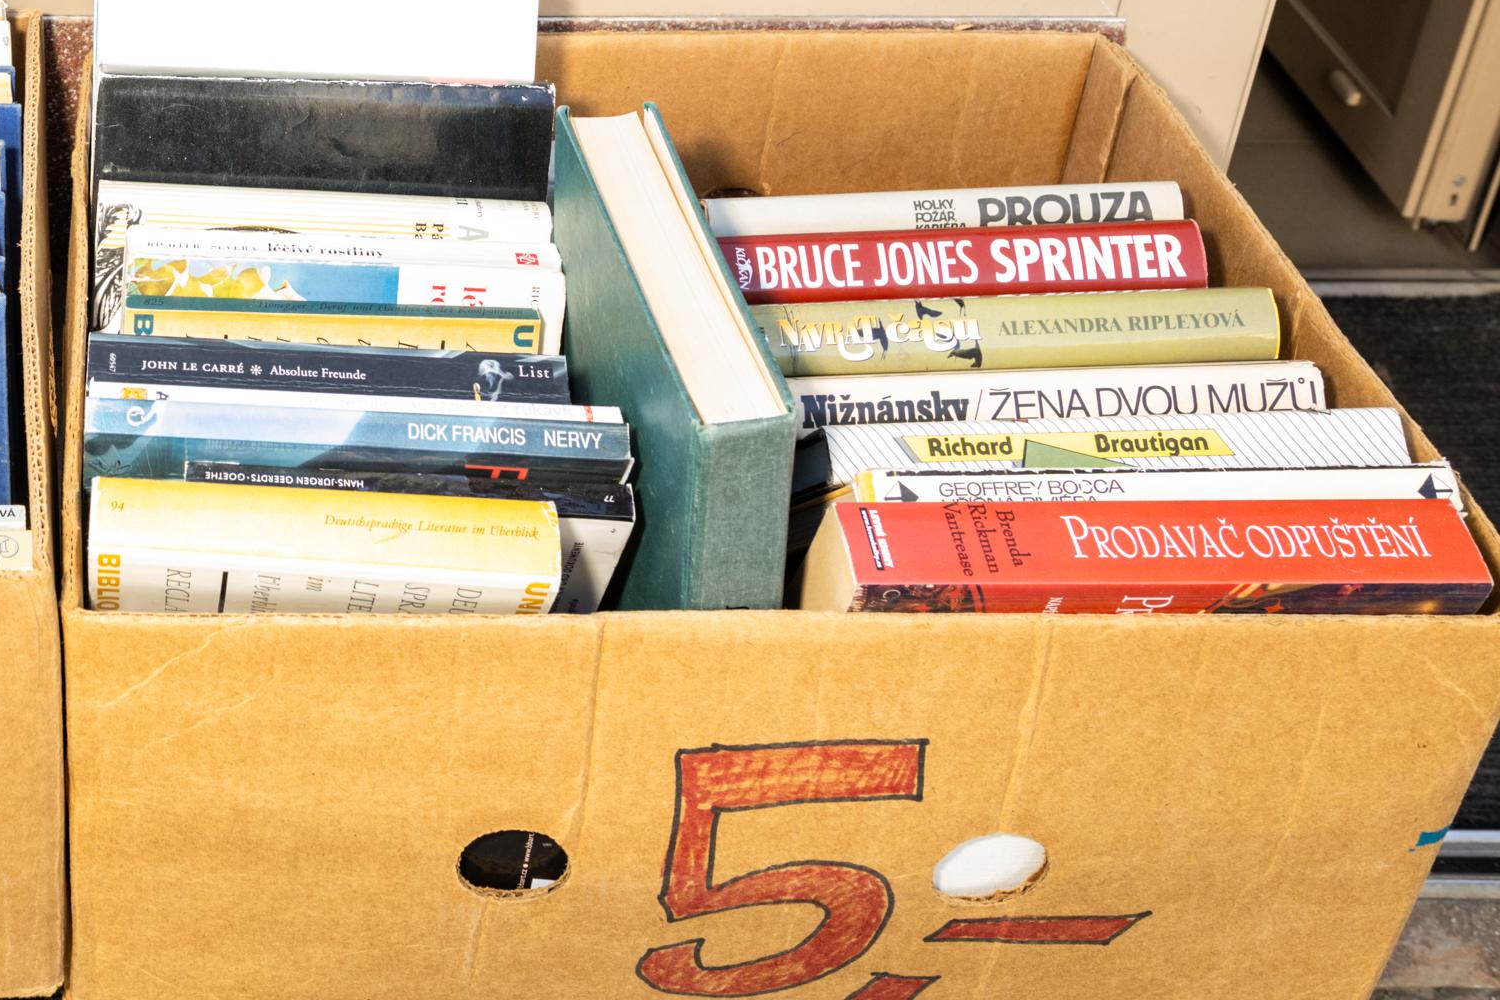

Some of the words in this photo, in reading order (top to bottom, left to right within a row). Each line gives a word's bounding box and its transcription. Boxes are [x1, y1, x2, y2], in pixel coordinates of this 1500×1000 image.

[977, 191, 1154, 228] PROUZA
[755, 242, 863, 290] BRUCE
[873, 238, 979, 285] JONES
[989, 233, 1188, 282] SPRINTER
[885, 312, 982, 351] času
[998, 316, 1123, 336] ALEXANDRA
[1127, 307, 1247, 333] RIPLEYOVÁ
[141, 358, 181, 371] JOHN
[182, 361, 199, 372] LE
[201, 359, 245, 375] CARRÉ
[268, 365, 318, 379] Absolute
[321, 368, 367, 382] Freunde
[517, 364, 551, 380] List
[801, 384, 971, 429] Nižnánsky
[987, 385, 1093, 421] ŽENA
[1097, 386, 1197, 418] DVOU
[1201, 376, 1322, 413] MUŽŮ
[407, 422, 450, 443] DICK
[452, 424, 527, 446] FRANCIS
[543, 429, 603, 450] NERVY
[926, 433, 1014, 458] Richard
[1094, 431, 1211, 458] Brautigan
[937, 478, 1044, 499] GEOFFREY
[1047, 477, 1125, 496] BOCCA
[323, 513, 414, 537] Deutschsprachige
[416, 520, 471, 536] Literatur
[471, 524, 486, 535] im
[489, 523, 540, 539] Überblick
[941, 501, 976, 578] Vantrease
[967, 501, 1000, 575] Rickman
[995, 509, 1026, 568] Brenda
[1059, 513, 1245, 560] PRODAVAČ
[1246, 513, 1432, 560] ODPUŠTĚNÍ
